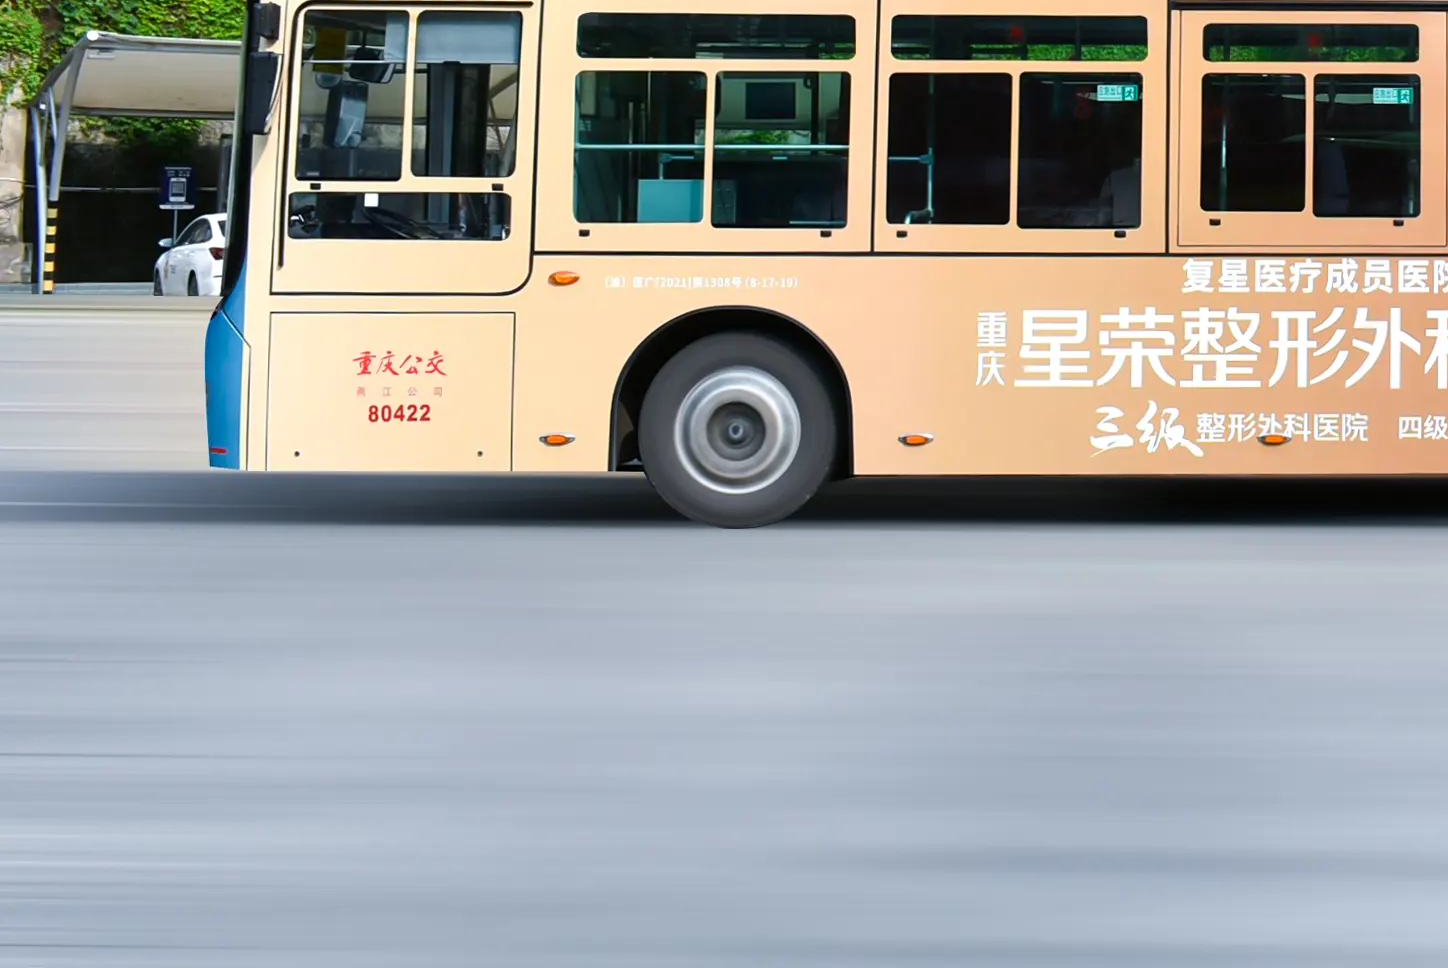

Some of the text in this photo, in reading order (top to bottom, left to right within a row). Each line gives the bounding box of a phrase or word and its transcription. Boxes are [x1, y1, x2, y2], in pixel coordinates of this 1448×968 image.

[352, 350, 447, 376] 重庆公交
[975, 311, 1008, 386] 重庆
[368, 404, 431, 422] 80422
[1089, 400, 1204, 457] 三级
[1196, 413, 1368, 442] 整形外科医院
